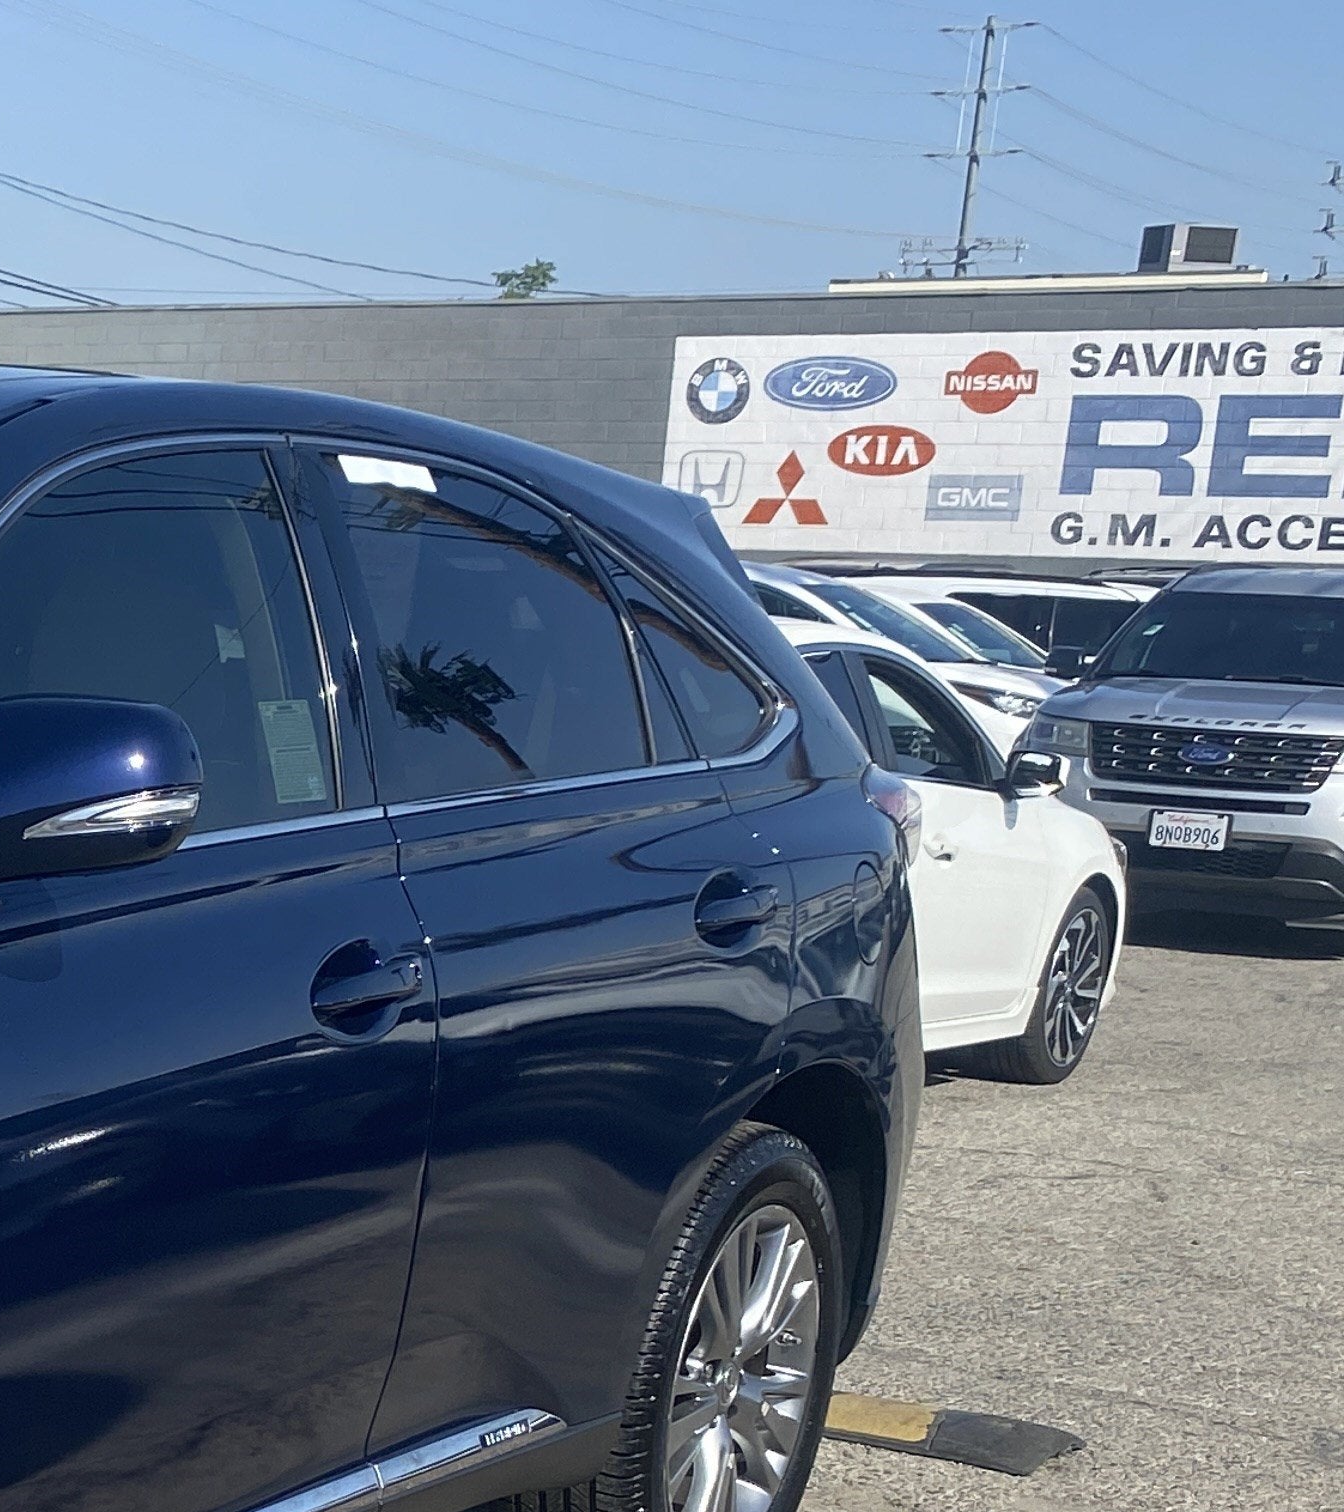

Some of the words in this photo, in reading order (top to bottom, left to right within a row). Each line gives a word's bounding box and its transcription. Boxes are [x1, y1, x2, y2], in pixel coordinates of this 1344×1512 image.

[1070, 341, 1267, 378] SAVING
[1290, 341, 1323, 376] &
[792, 367, 869, 399] Ford
[949, 372, 1033, 393] NISSAN
[844, 434, 920, 466] KIA
[1059, 394, 1344, 498] RE
[937, 487, 1010, 508] GMC
[1051, 512, 1171, 547] G.M.
[1192, 514, 1344, 551] ACCE
